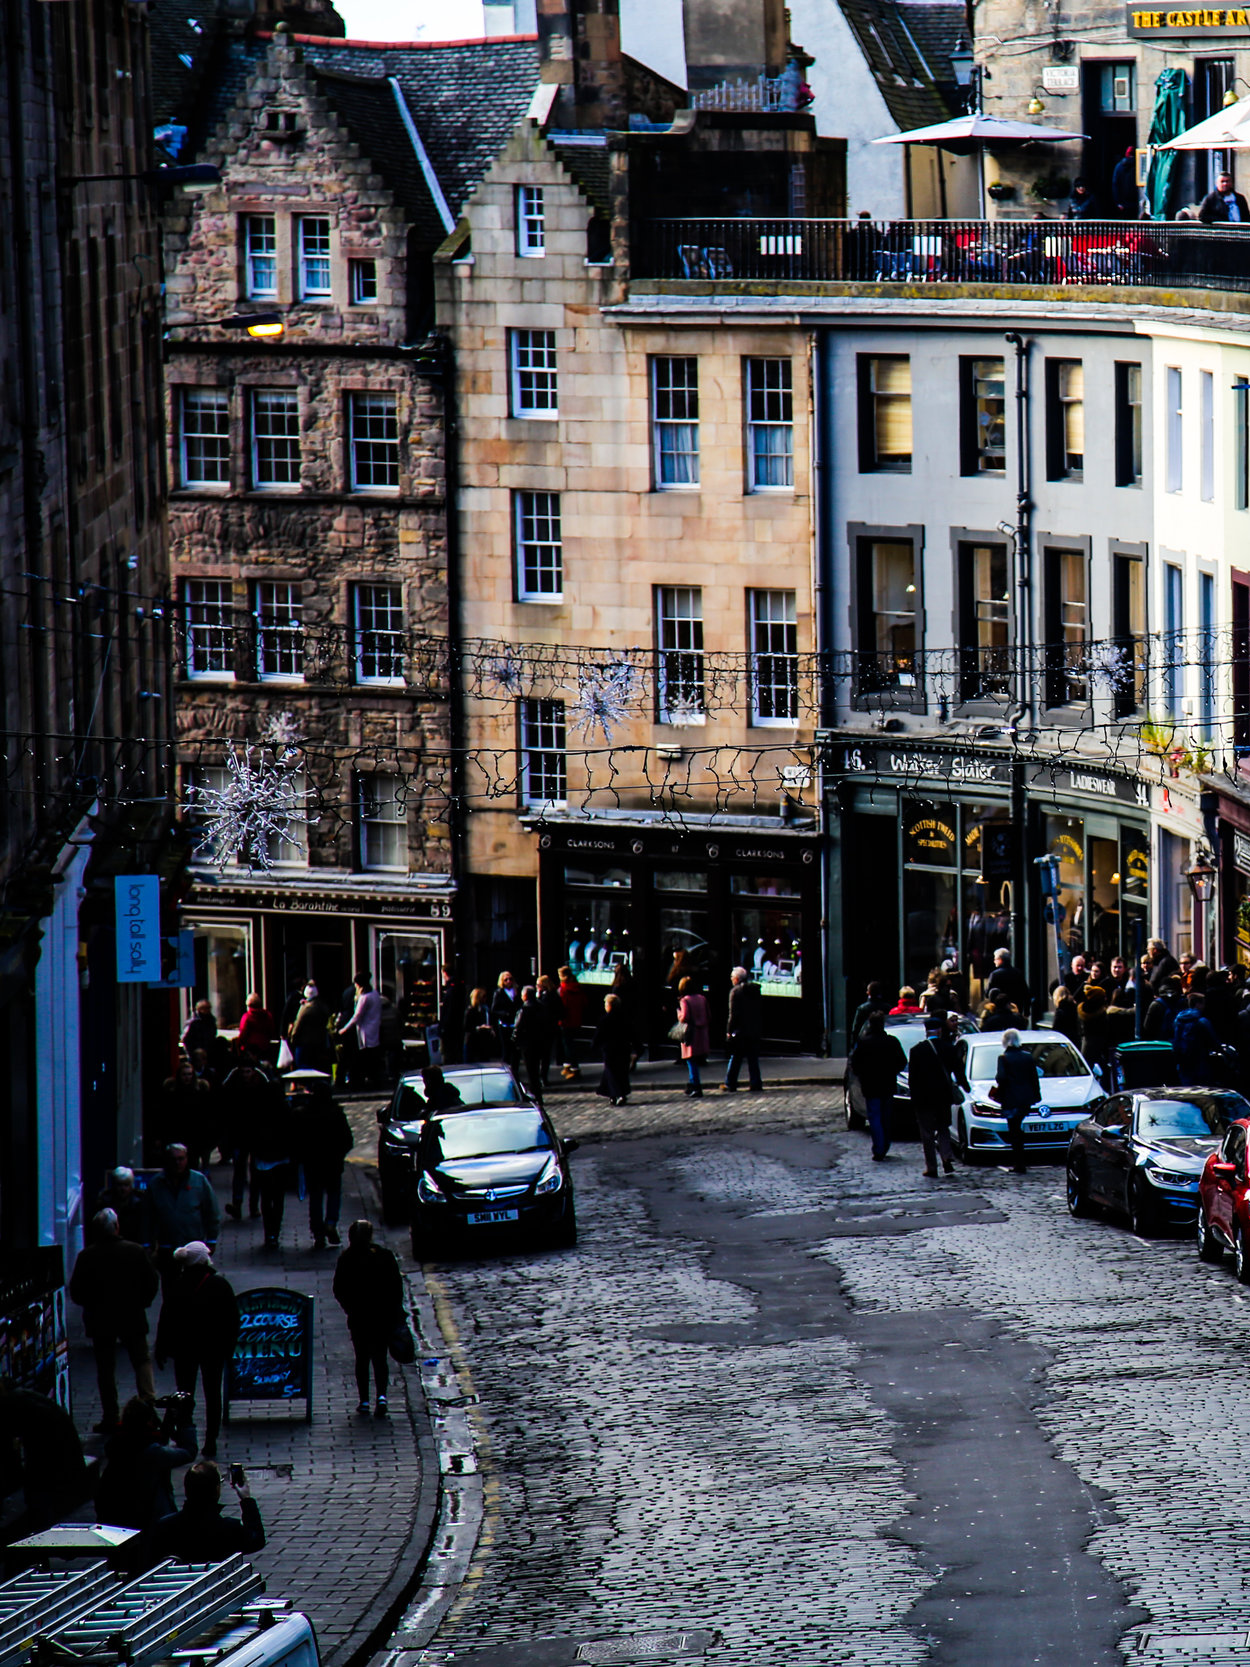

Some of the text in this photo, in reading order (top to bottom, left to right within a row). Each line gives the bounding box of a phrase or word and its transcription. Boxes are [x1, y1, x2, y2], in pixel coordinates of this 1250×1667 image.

[1131, 11, 1160, 28] THE
[1166, 9, 1219, 27] CASTLE
[890, 754, 996, 781] Walker Slater
[1070, 771, 1116, 796] LADIESWEAR
[567, 839, 615, 850] CLARKSONS
[736, 849, 785, 860] CLARKSONS
[430, 904, 452, 918] 89
[124, 884, 147, 974] long tall sally
[253, 1312, 298, 1328] COURSE
[237, 1329, 303, 1343] LUNCH
[232, 1342, 302, 1359] MENU
